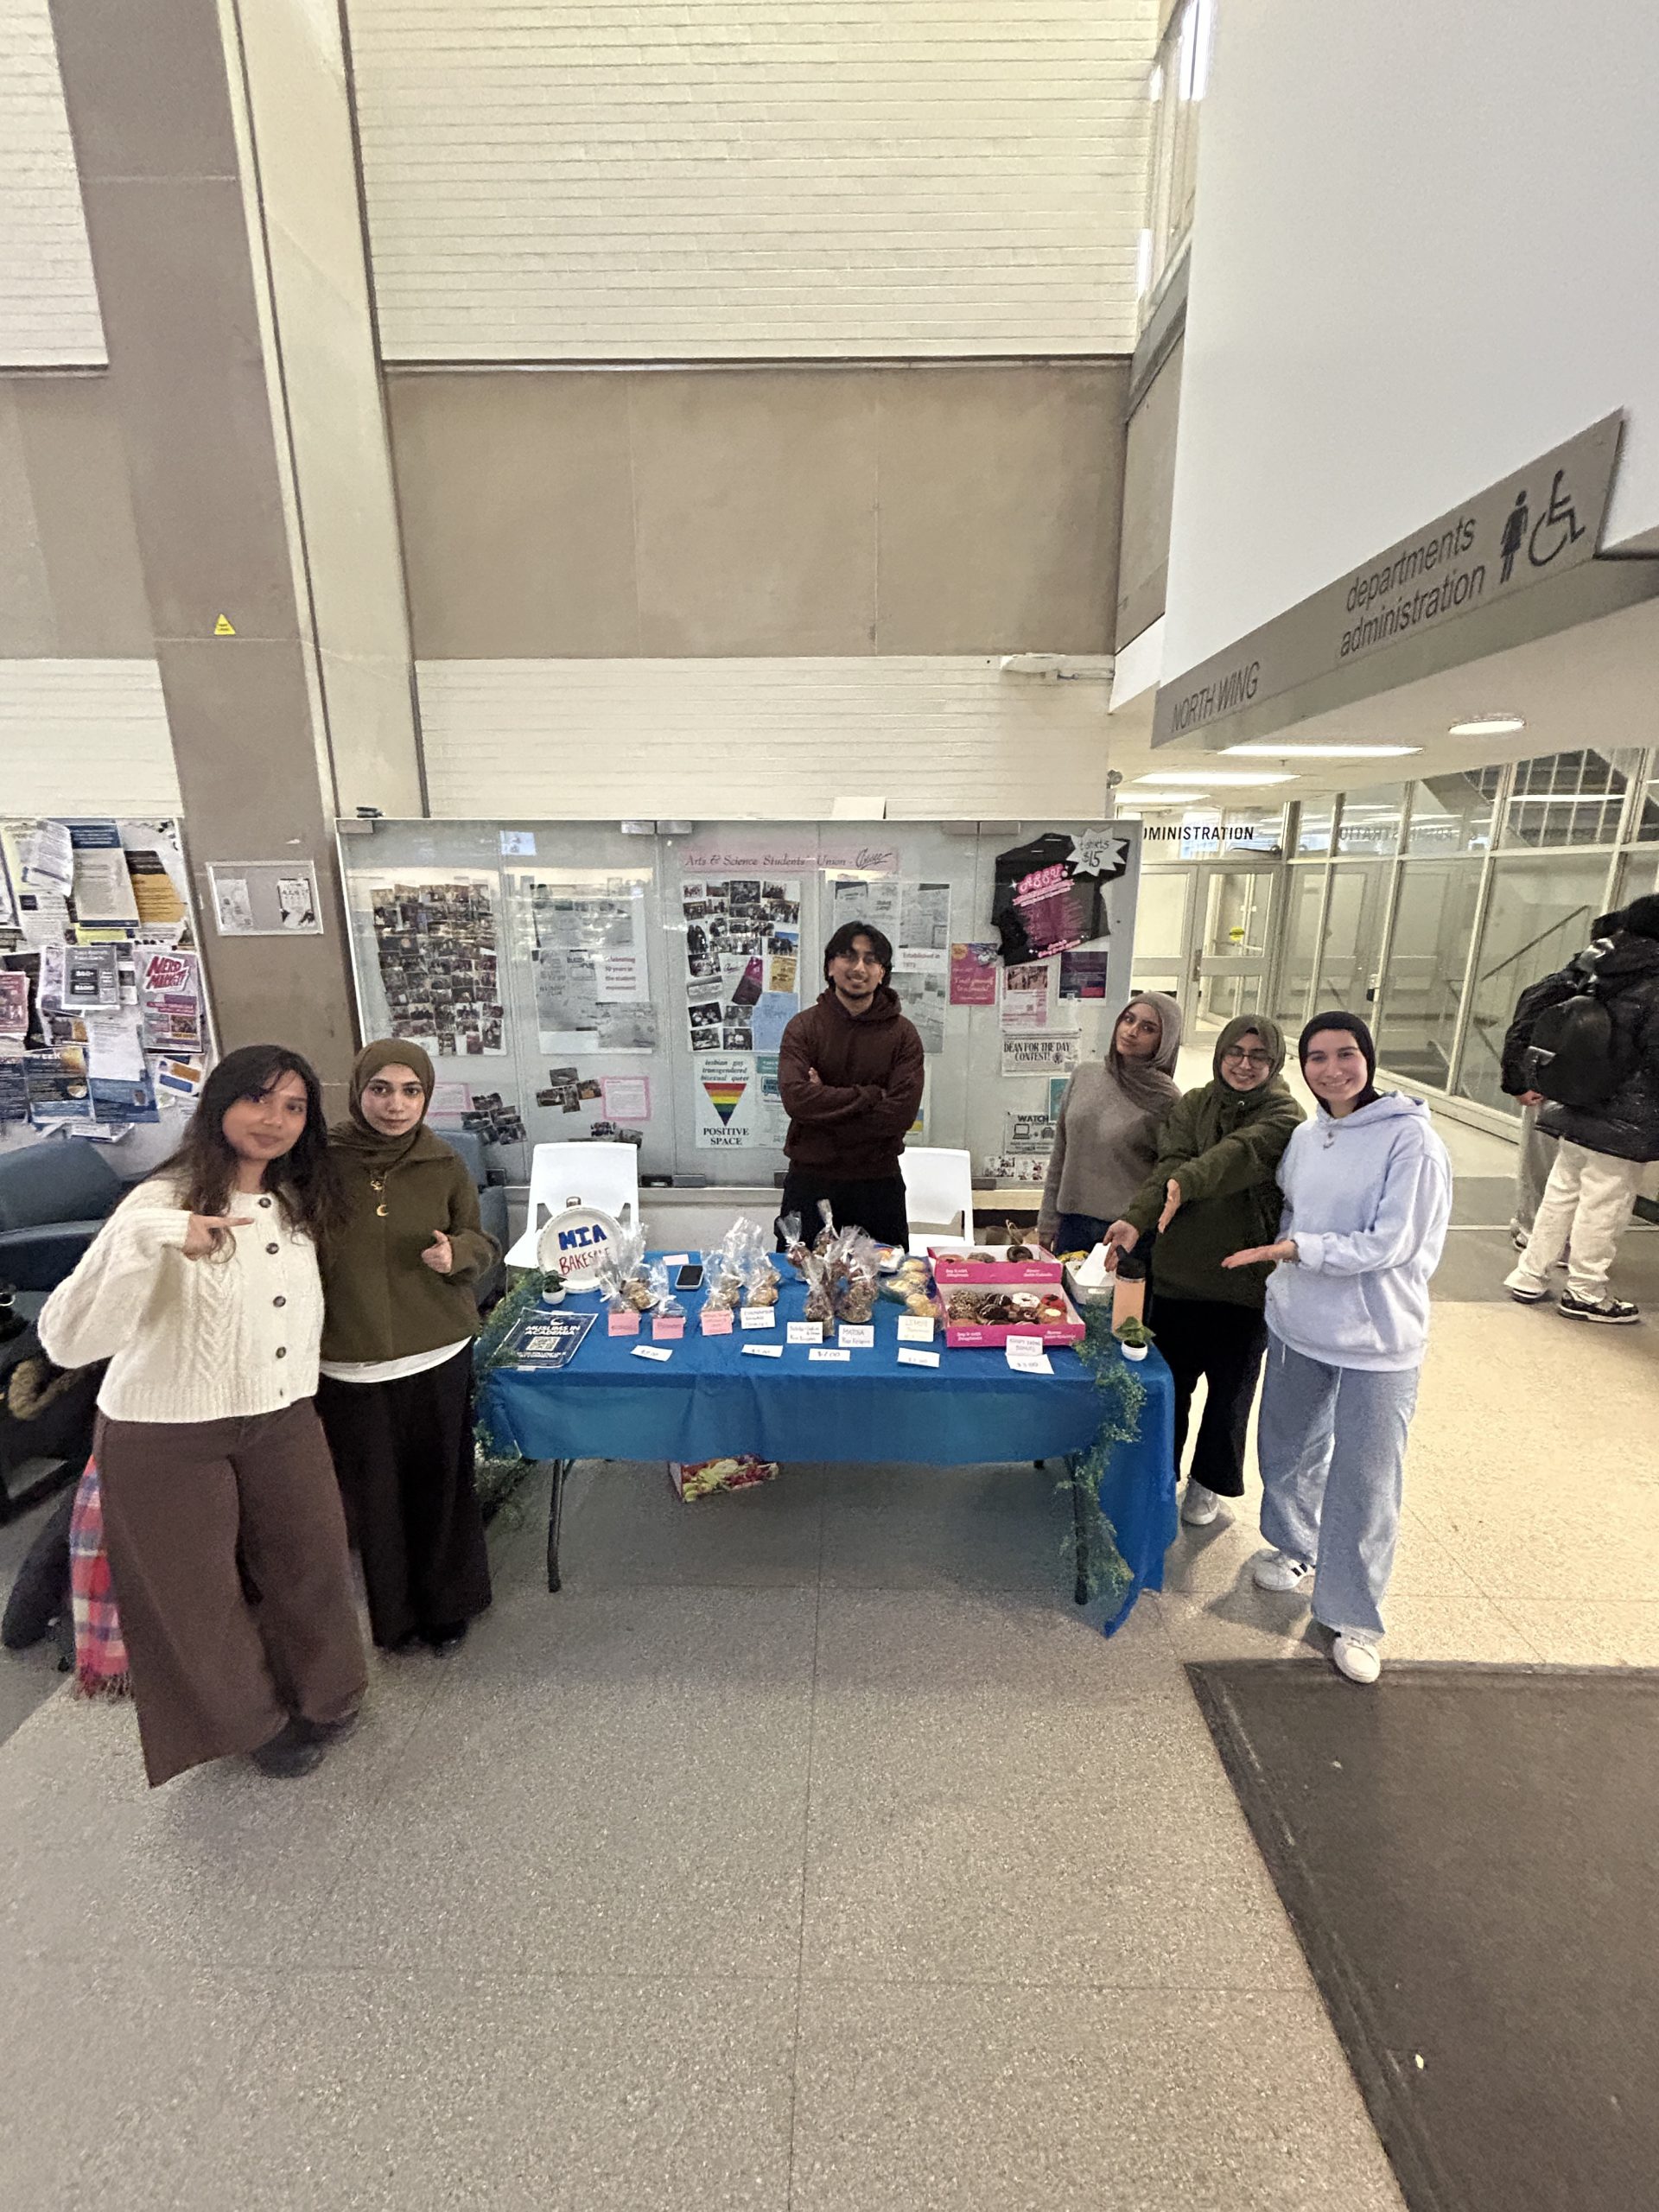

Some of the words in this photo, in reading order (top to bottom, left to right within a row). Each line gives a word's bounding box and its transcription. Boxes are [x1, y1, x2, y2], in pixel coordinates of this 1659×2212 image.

[1346, 517, 1476, 612] departments
[1340, 564, 1485, 657] administration
[1171, 683, 1216, 733] NORTH
[1217, 661, 1260, 712] WING
[685, 855, 706, 866] Arts
[709, 855, 721, 865] &
[723, 855, 758, 866] Science
[1082, 850, 1103, 868] $15
[1004, 1042, 1023, 1052] DEAN
[1024, 1042, 1039, 1052] FOR
[1041, 1042, 1054, 1052] THE
[1056, 1042, 1071, 1052] DAY
[558, 1224, 607, 1251] MIA
